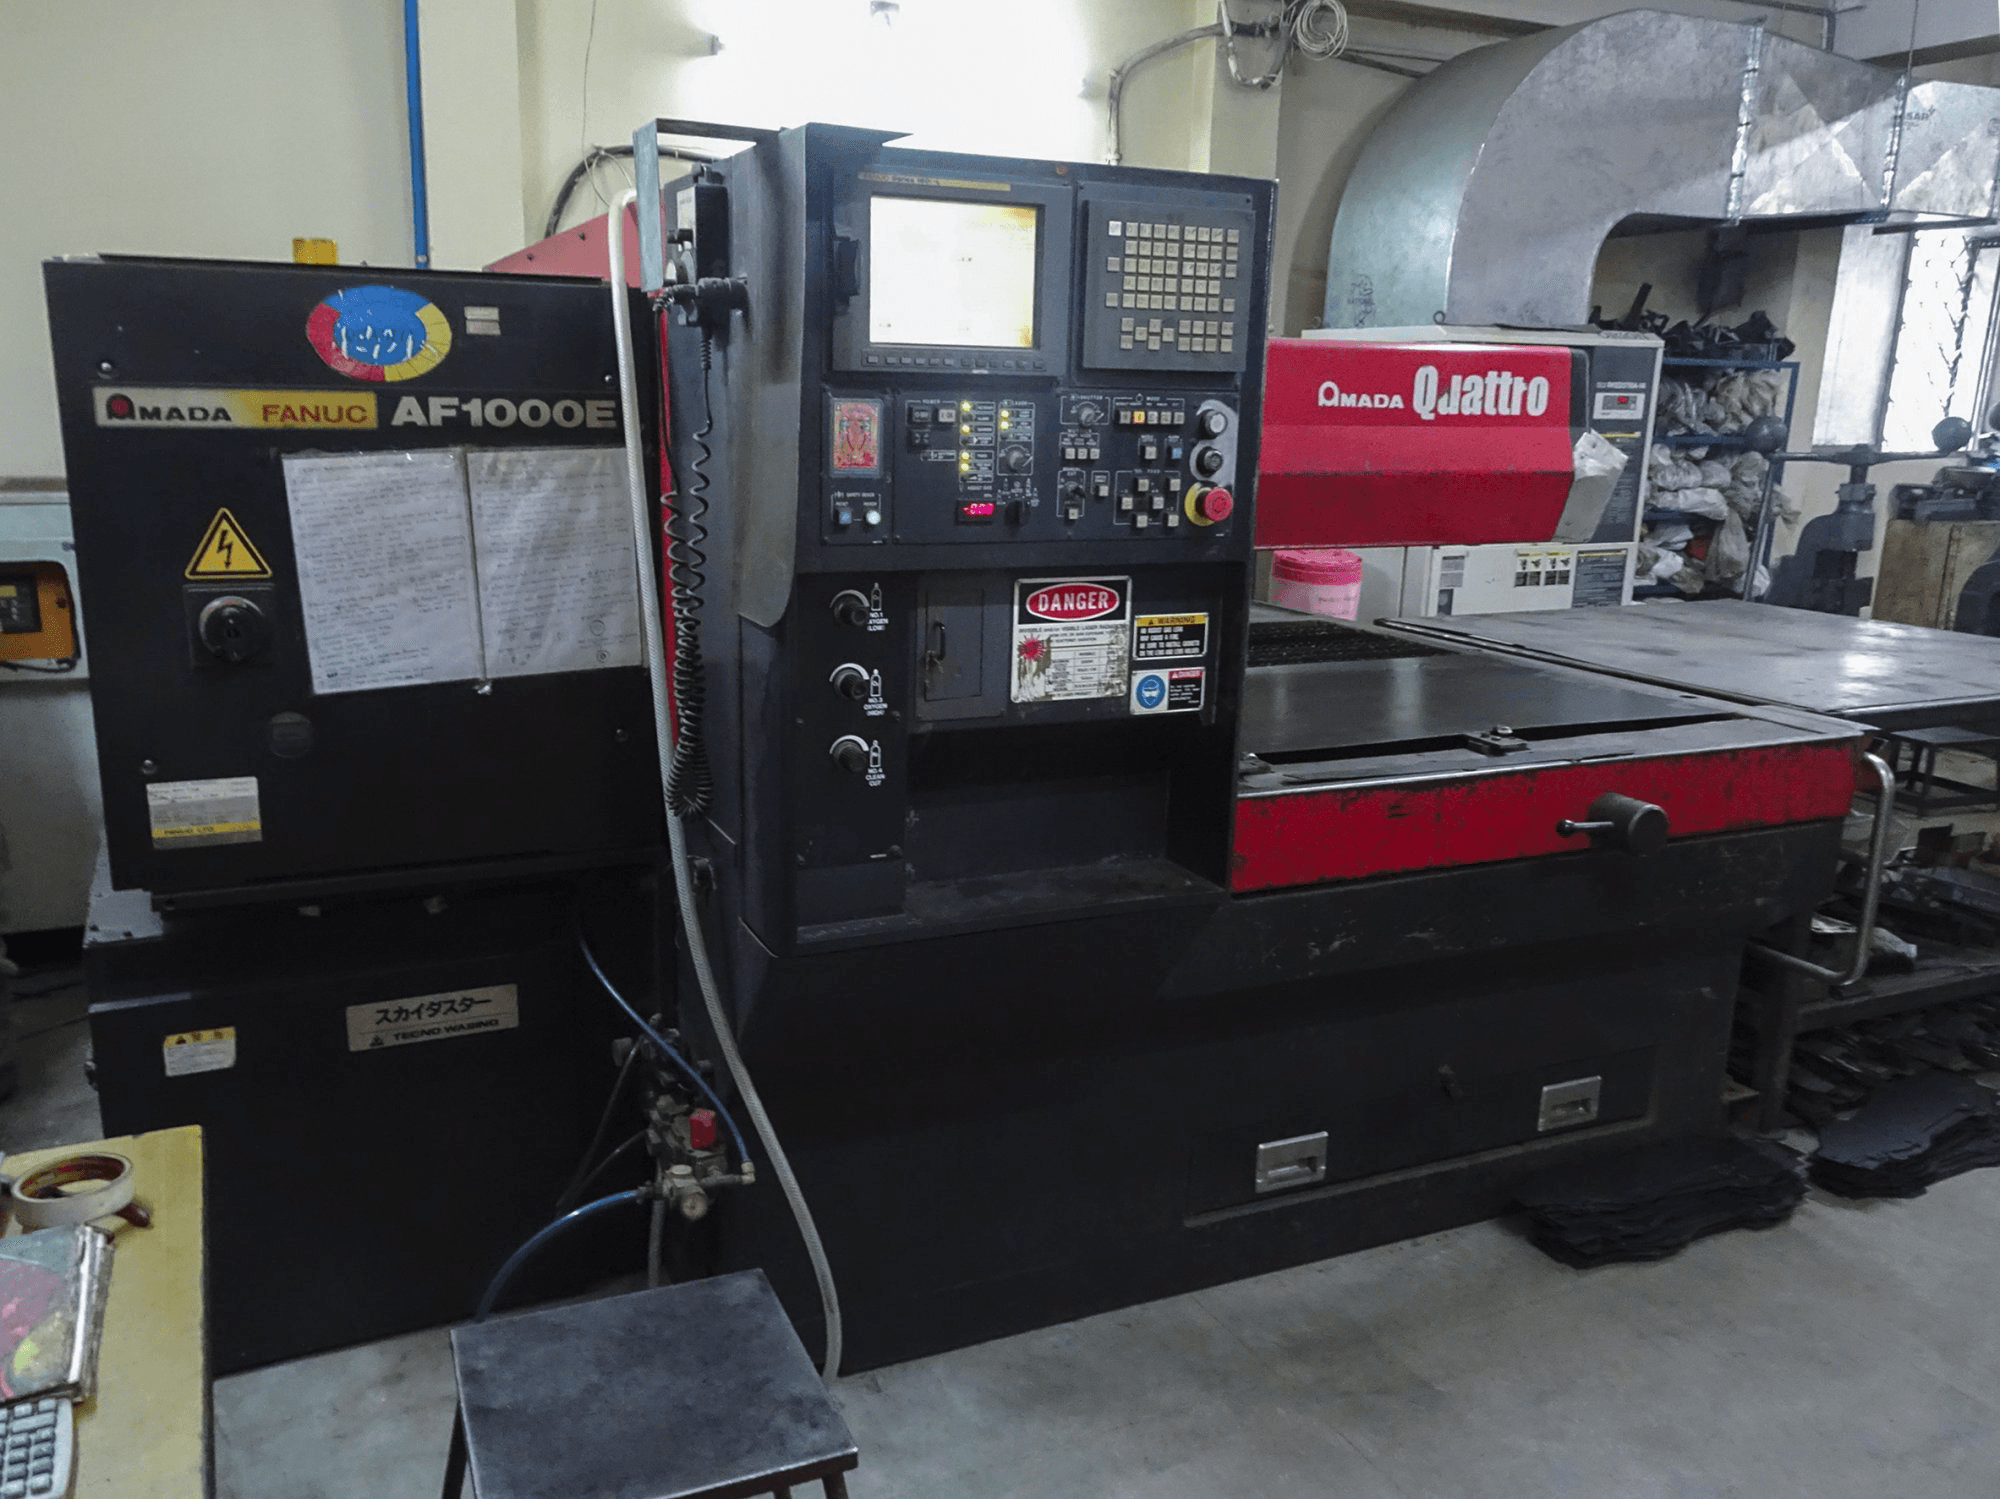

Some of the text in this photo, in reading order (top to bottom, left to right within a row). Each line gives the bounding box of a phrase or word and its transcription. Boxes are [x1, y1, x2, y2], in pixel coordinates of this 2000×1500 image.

[1412, 365, 1549, 421] Quattro
[262, 404, 368, 423] FANUC
[390, 395, 617, 428] AF1000E
[1038, 591, 1109, 612] DANGER
[374, 997, 493, 1025] スカイダスター
[393, 1027, 442, 1041] TECNO
